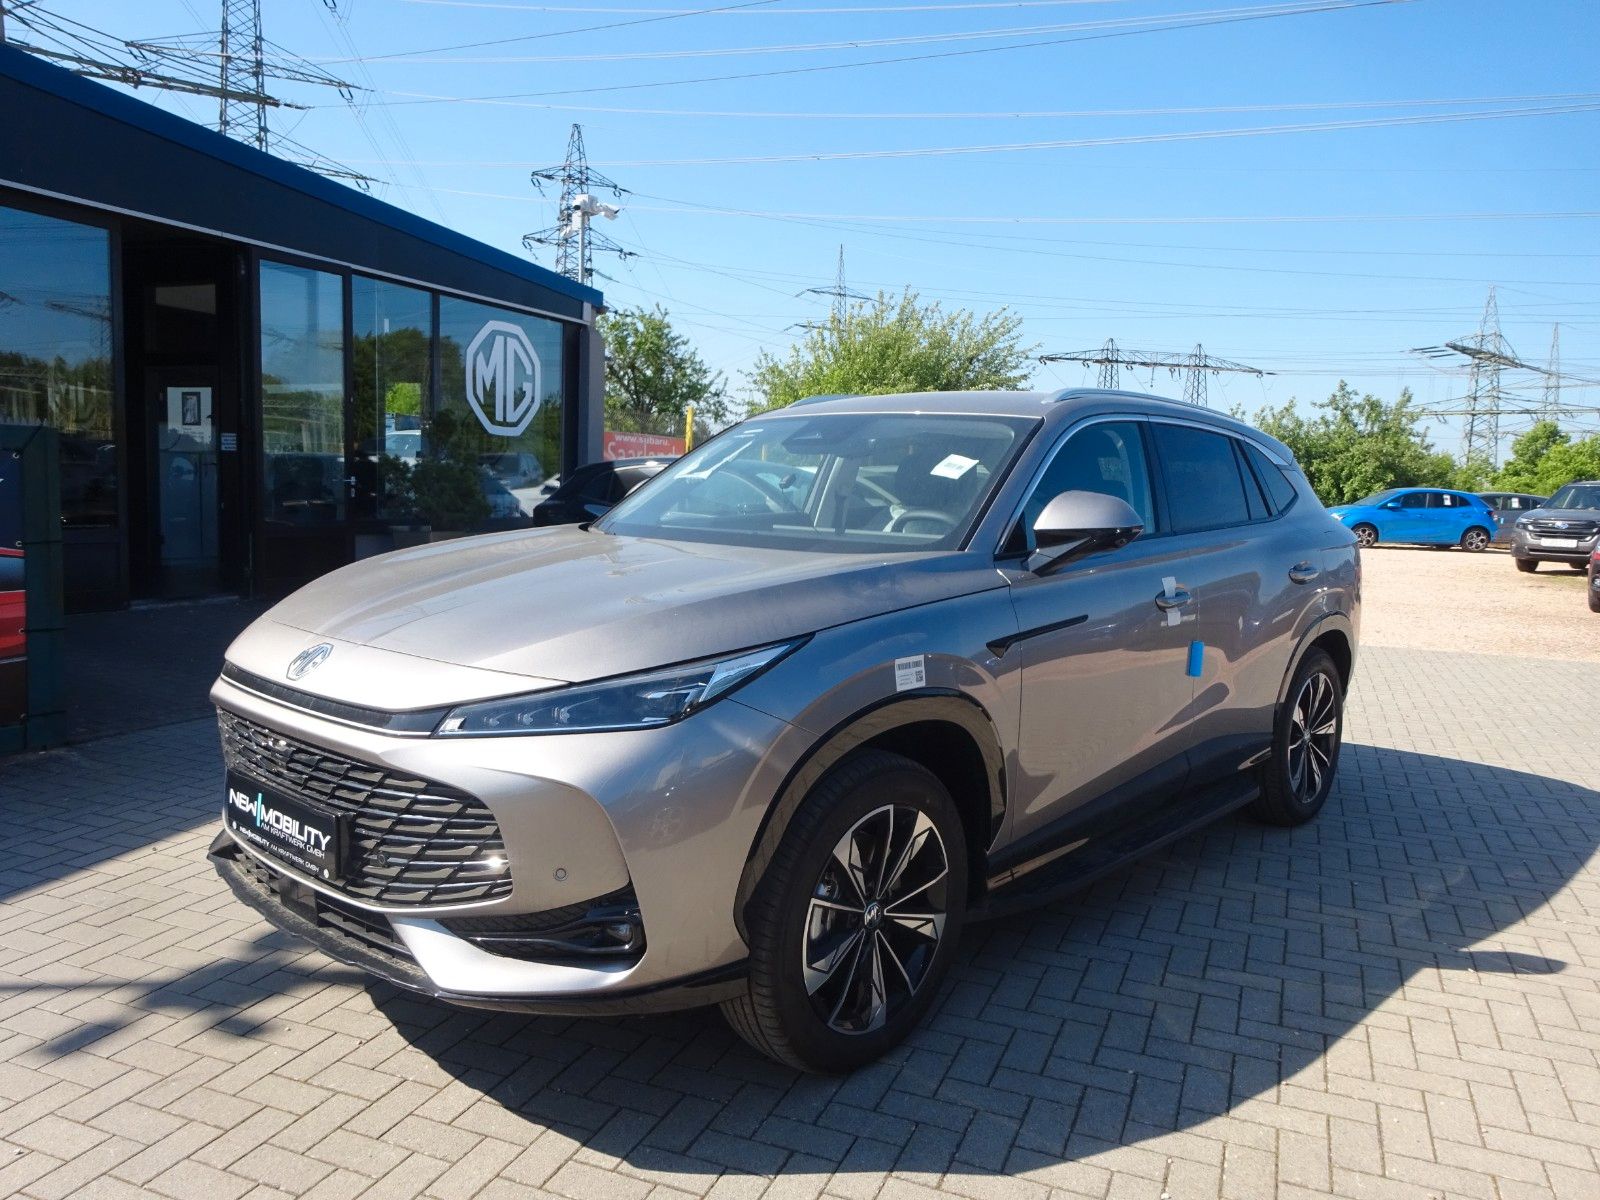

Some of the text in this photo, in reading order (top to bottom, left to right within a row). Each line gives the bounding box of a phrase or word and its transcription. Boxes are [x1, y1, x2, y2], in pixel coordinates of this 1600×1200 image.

[476, 335, 533, 423] MG
[229, 788, 331, 851] NEW MOBILITY
[261, 822, 270, 832] AM
[270, 826, 305, 850] KRAFTWERK
